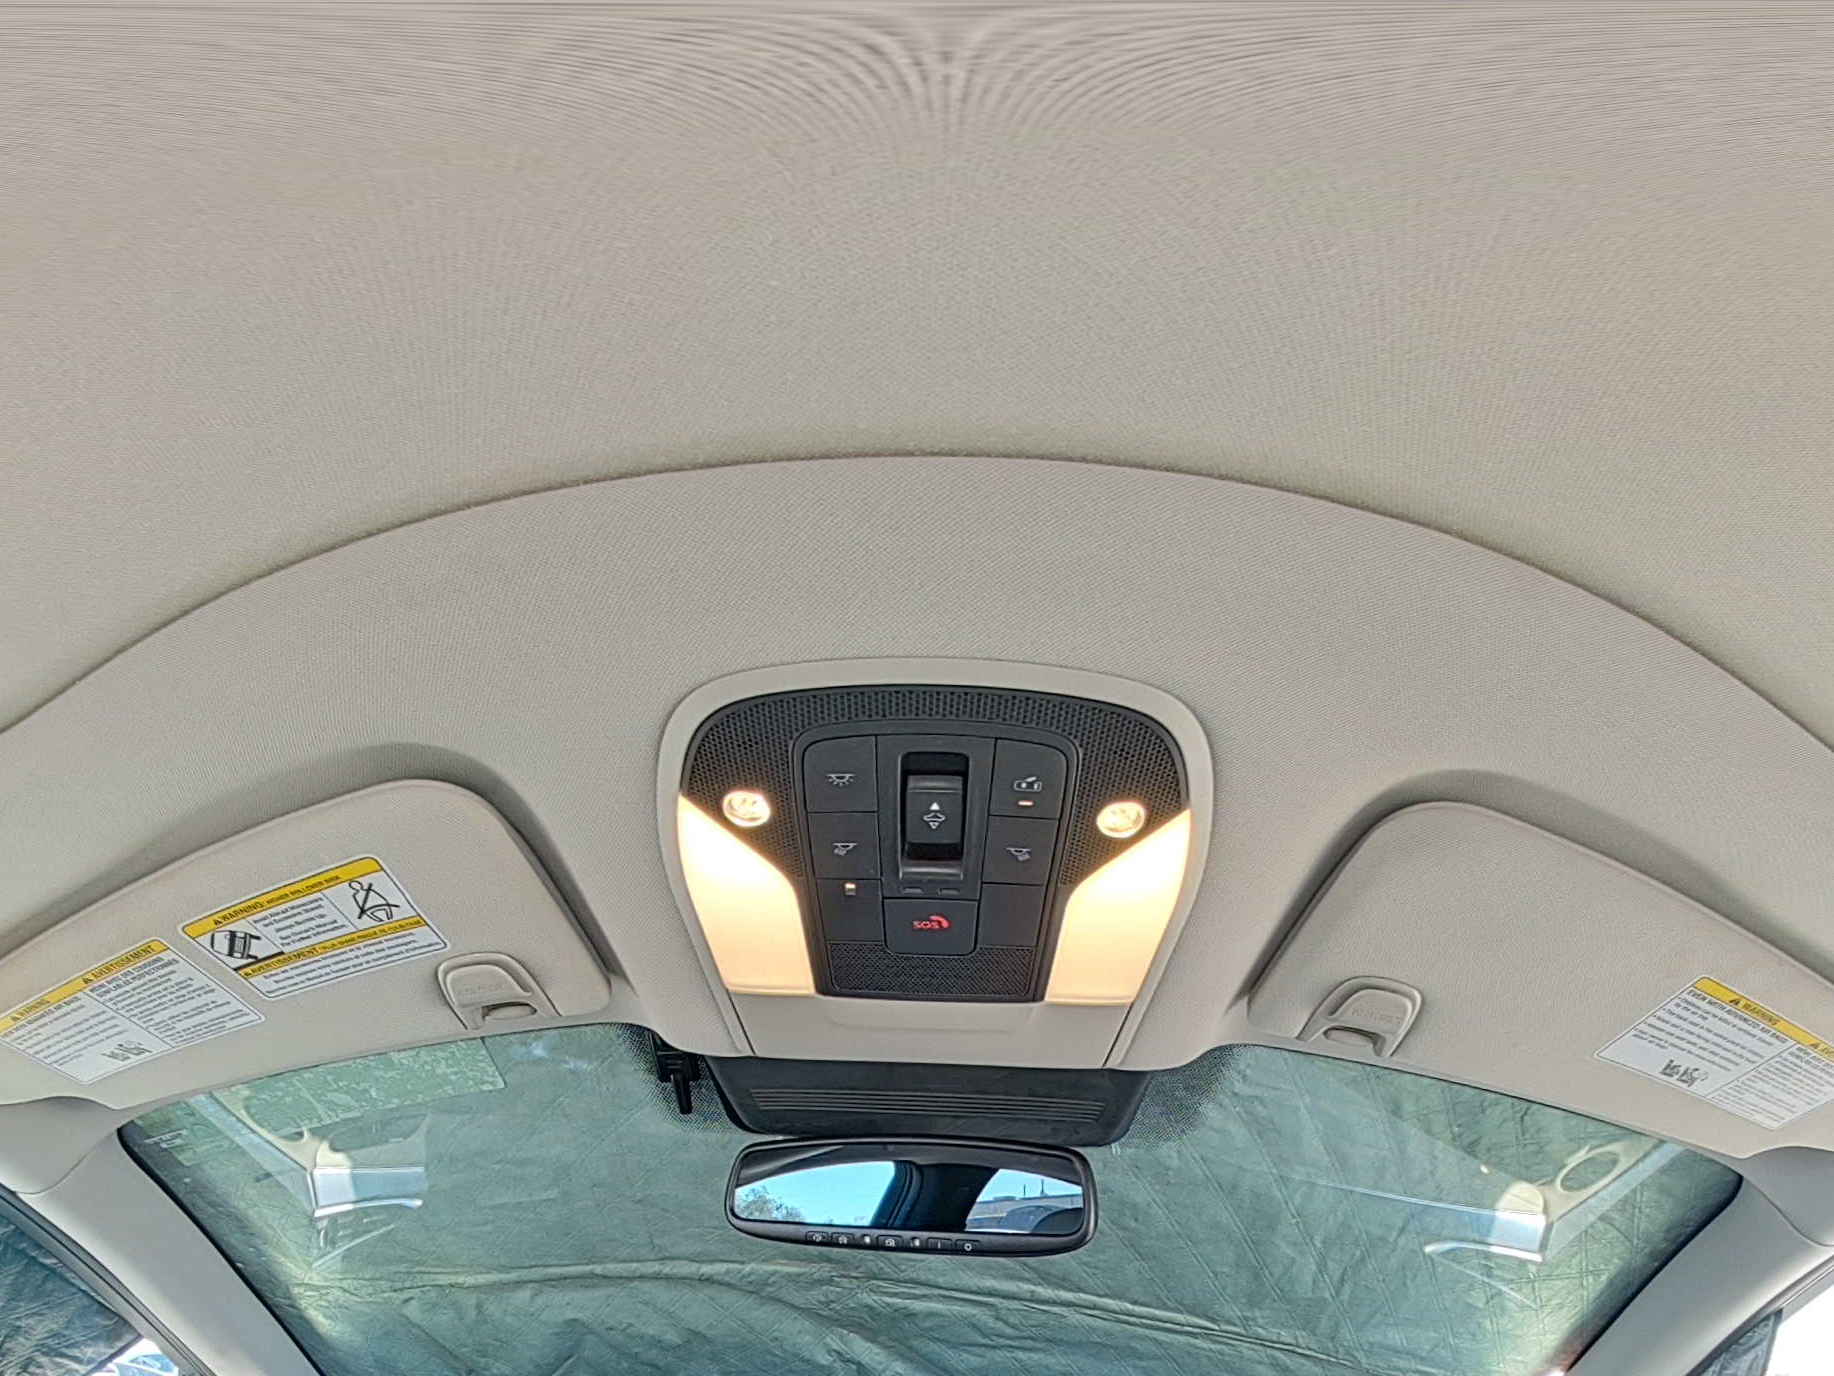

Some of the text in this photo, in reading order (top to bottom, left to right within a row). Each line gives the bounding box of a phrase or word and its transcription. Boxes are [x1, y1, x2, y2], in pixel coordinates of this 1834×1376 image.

[913, 920, 941, 930] SOS
[92, 944, 154, 979] AVERTISSEMENT
[1687, 989, 1705, 1002] EVEN
[1706, 998, 1726, 1011] WITH
[1724, 1008, 1759, 1029] ADVANCED
[1758, 1025, 1771, 1035] AIR
[1741, 1001, 1779, 1025] WARNING
